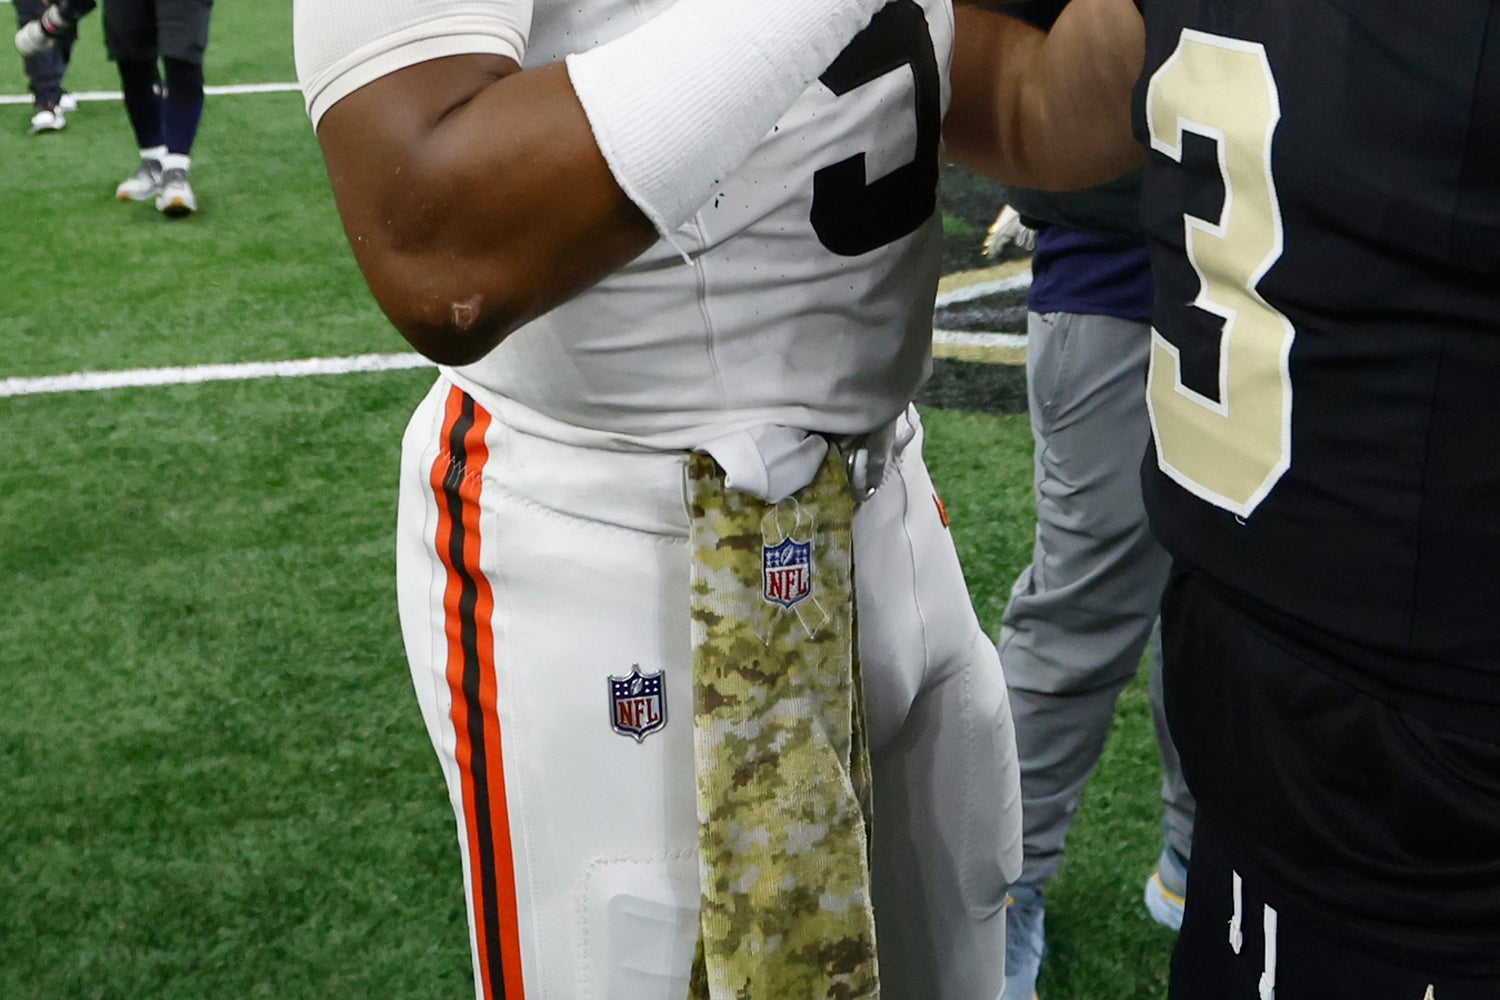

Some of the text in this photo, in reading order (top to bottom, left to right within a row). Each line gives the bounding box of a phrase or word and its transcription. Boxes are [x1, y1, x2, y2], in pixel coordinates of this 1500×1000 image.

[1146, 27, 1295, 517] 3
[767, 567, 808, 601] NFL
[617, 697, 660, 729] NFL
